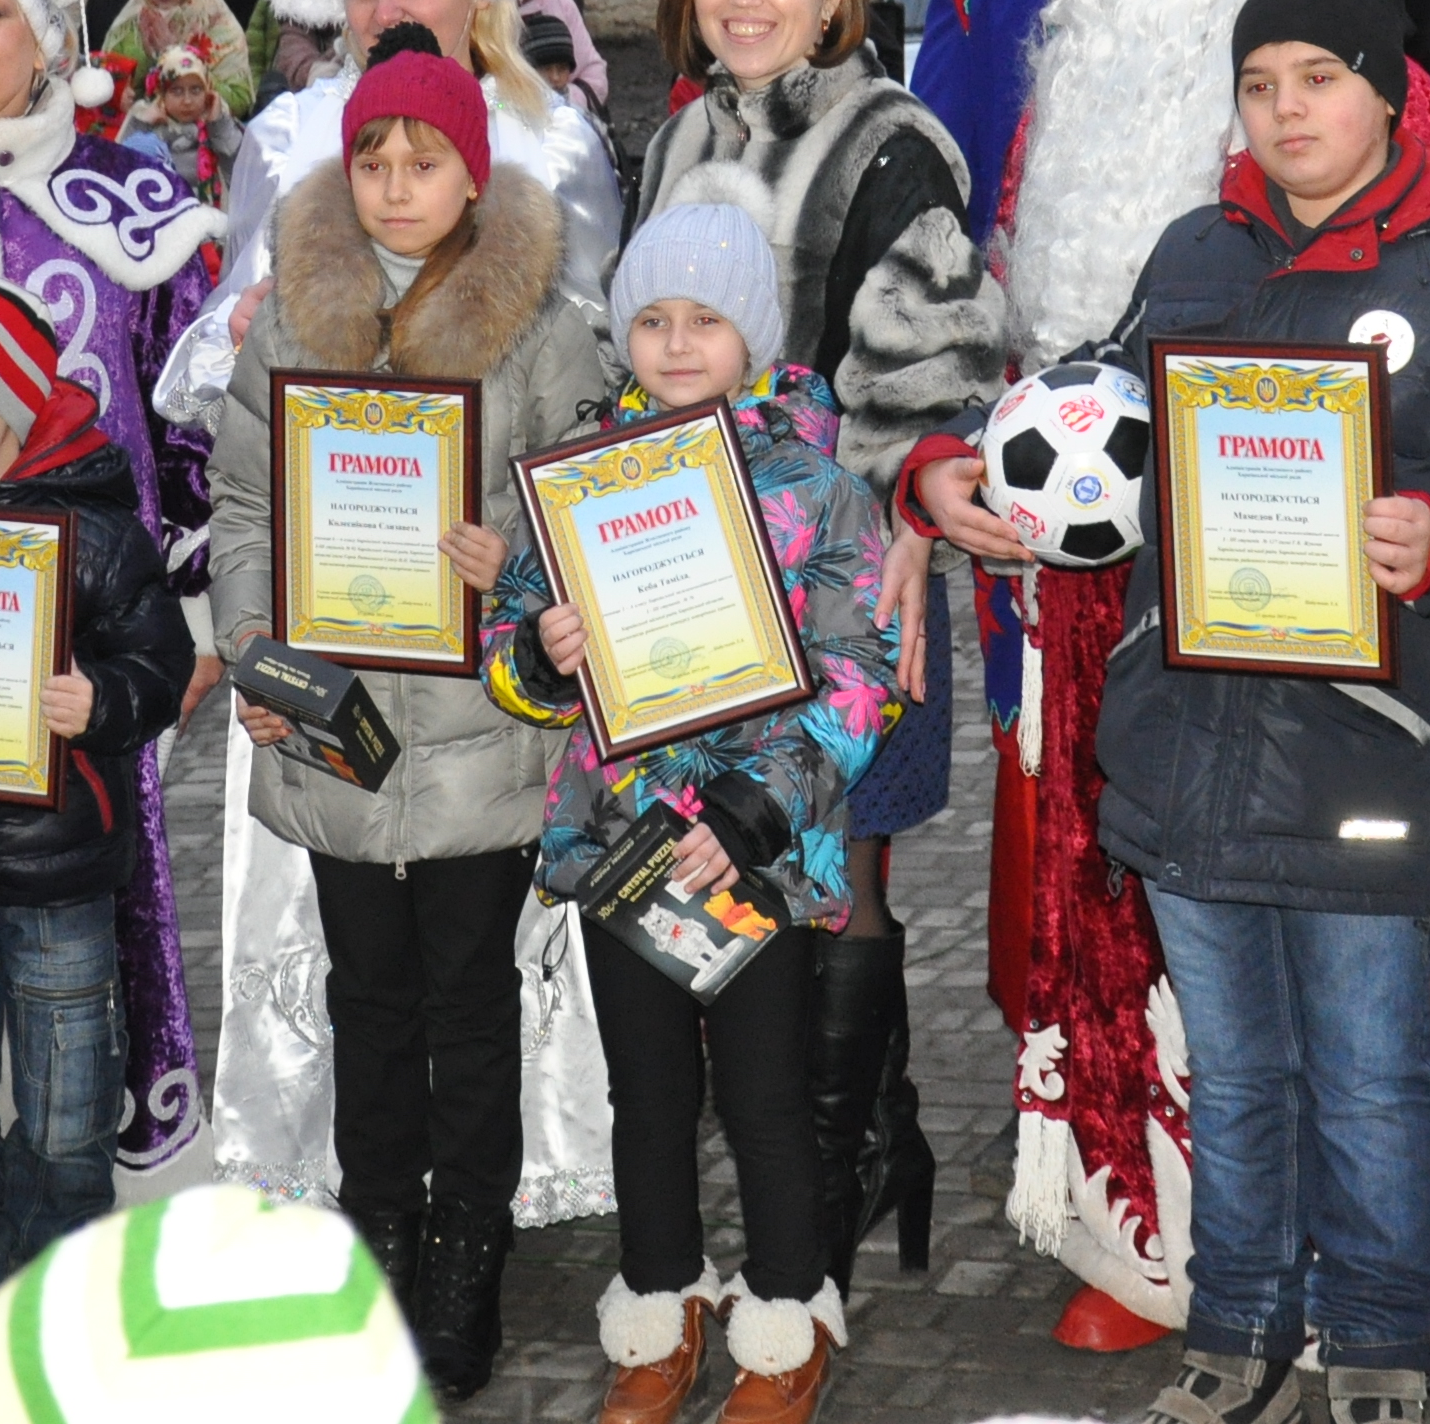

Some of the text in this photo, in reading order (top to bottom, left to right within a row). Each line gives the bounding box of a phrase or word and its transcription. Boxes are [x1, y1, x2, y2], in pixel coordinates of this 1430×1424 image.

[1218, 435, 1325, 462] ГРАМОТА
[328, 452, 422, 478] ГРАМОТА
[1221, 492, 1320, 506] НАГОРОДЖУЄТЬСЯ
[597, 496, 699, 543] ГРАМОТА
[612, 548, 704, 583] НАГОРОДЖУЄТЬСЯ
[617, 866, 652, 899] CRYSTAL
[647, 837, 677, 868] PUZZLE
